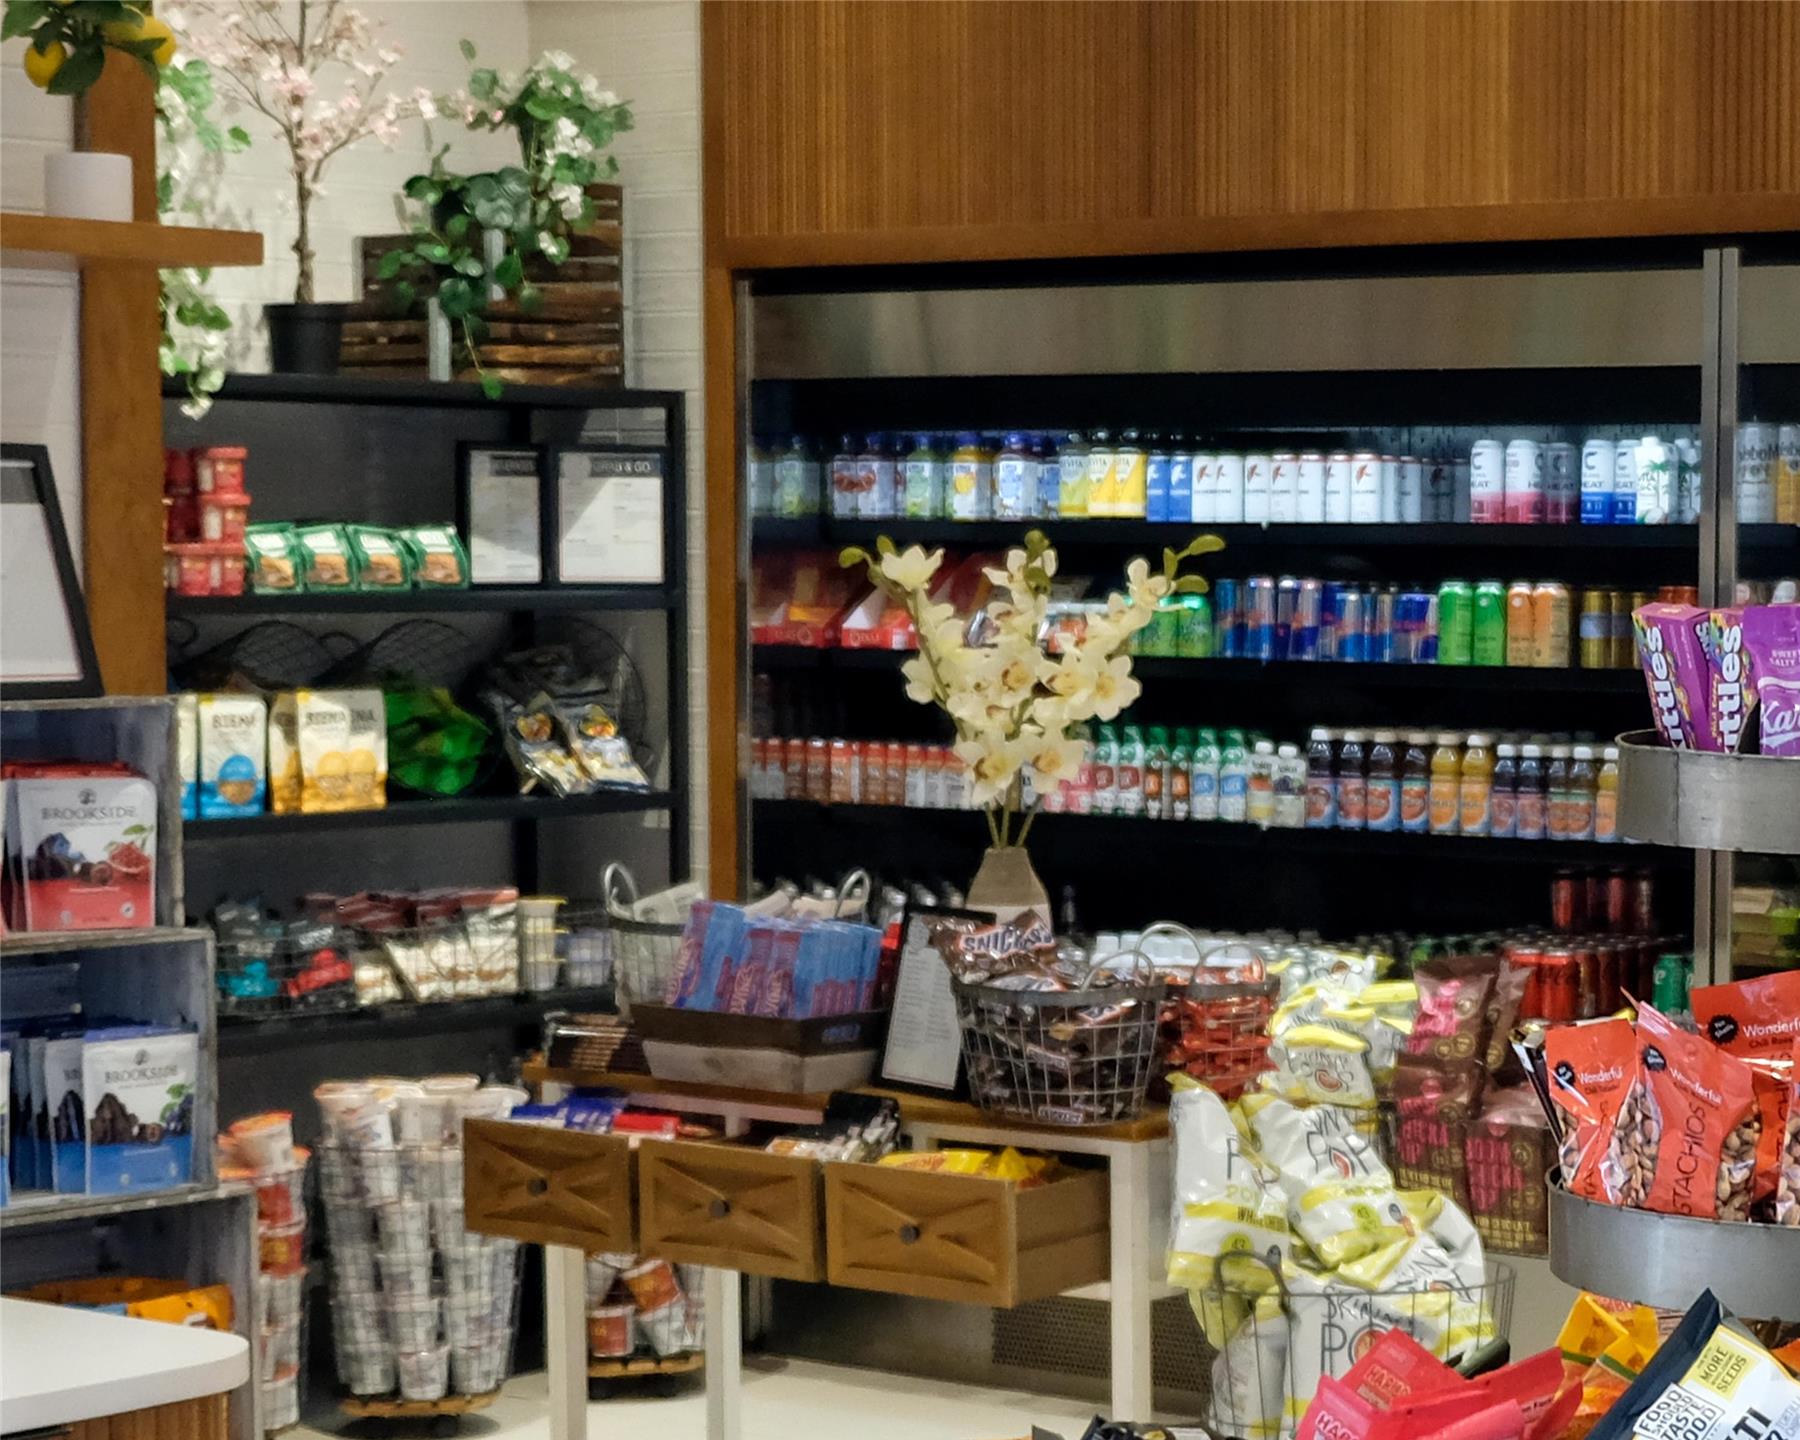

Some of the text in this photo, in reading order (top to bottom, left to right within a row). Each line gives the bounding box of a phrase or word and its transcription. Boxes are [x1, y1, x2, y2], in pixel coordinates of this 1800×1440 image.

[40, 804, 138, 822] BROOKSIDE
[1577, 1066, 1624, 1085] Wonderful
[1671, 1102, 1708, 1215] STACHIOS
[1716, 1354, 1748, 1394] SEEDS
[1638, 1389, 1683, 1433] FOOD
